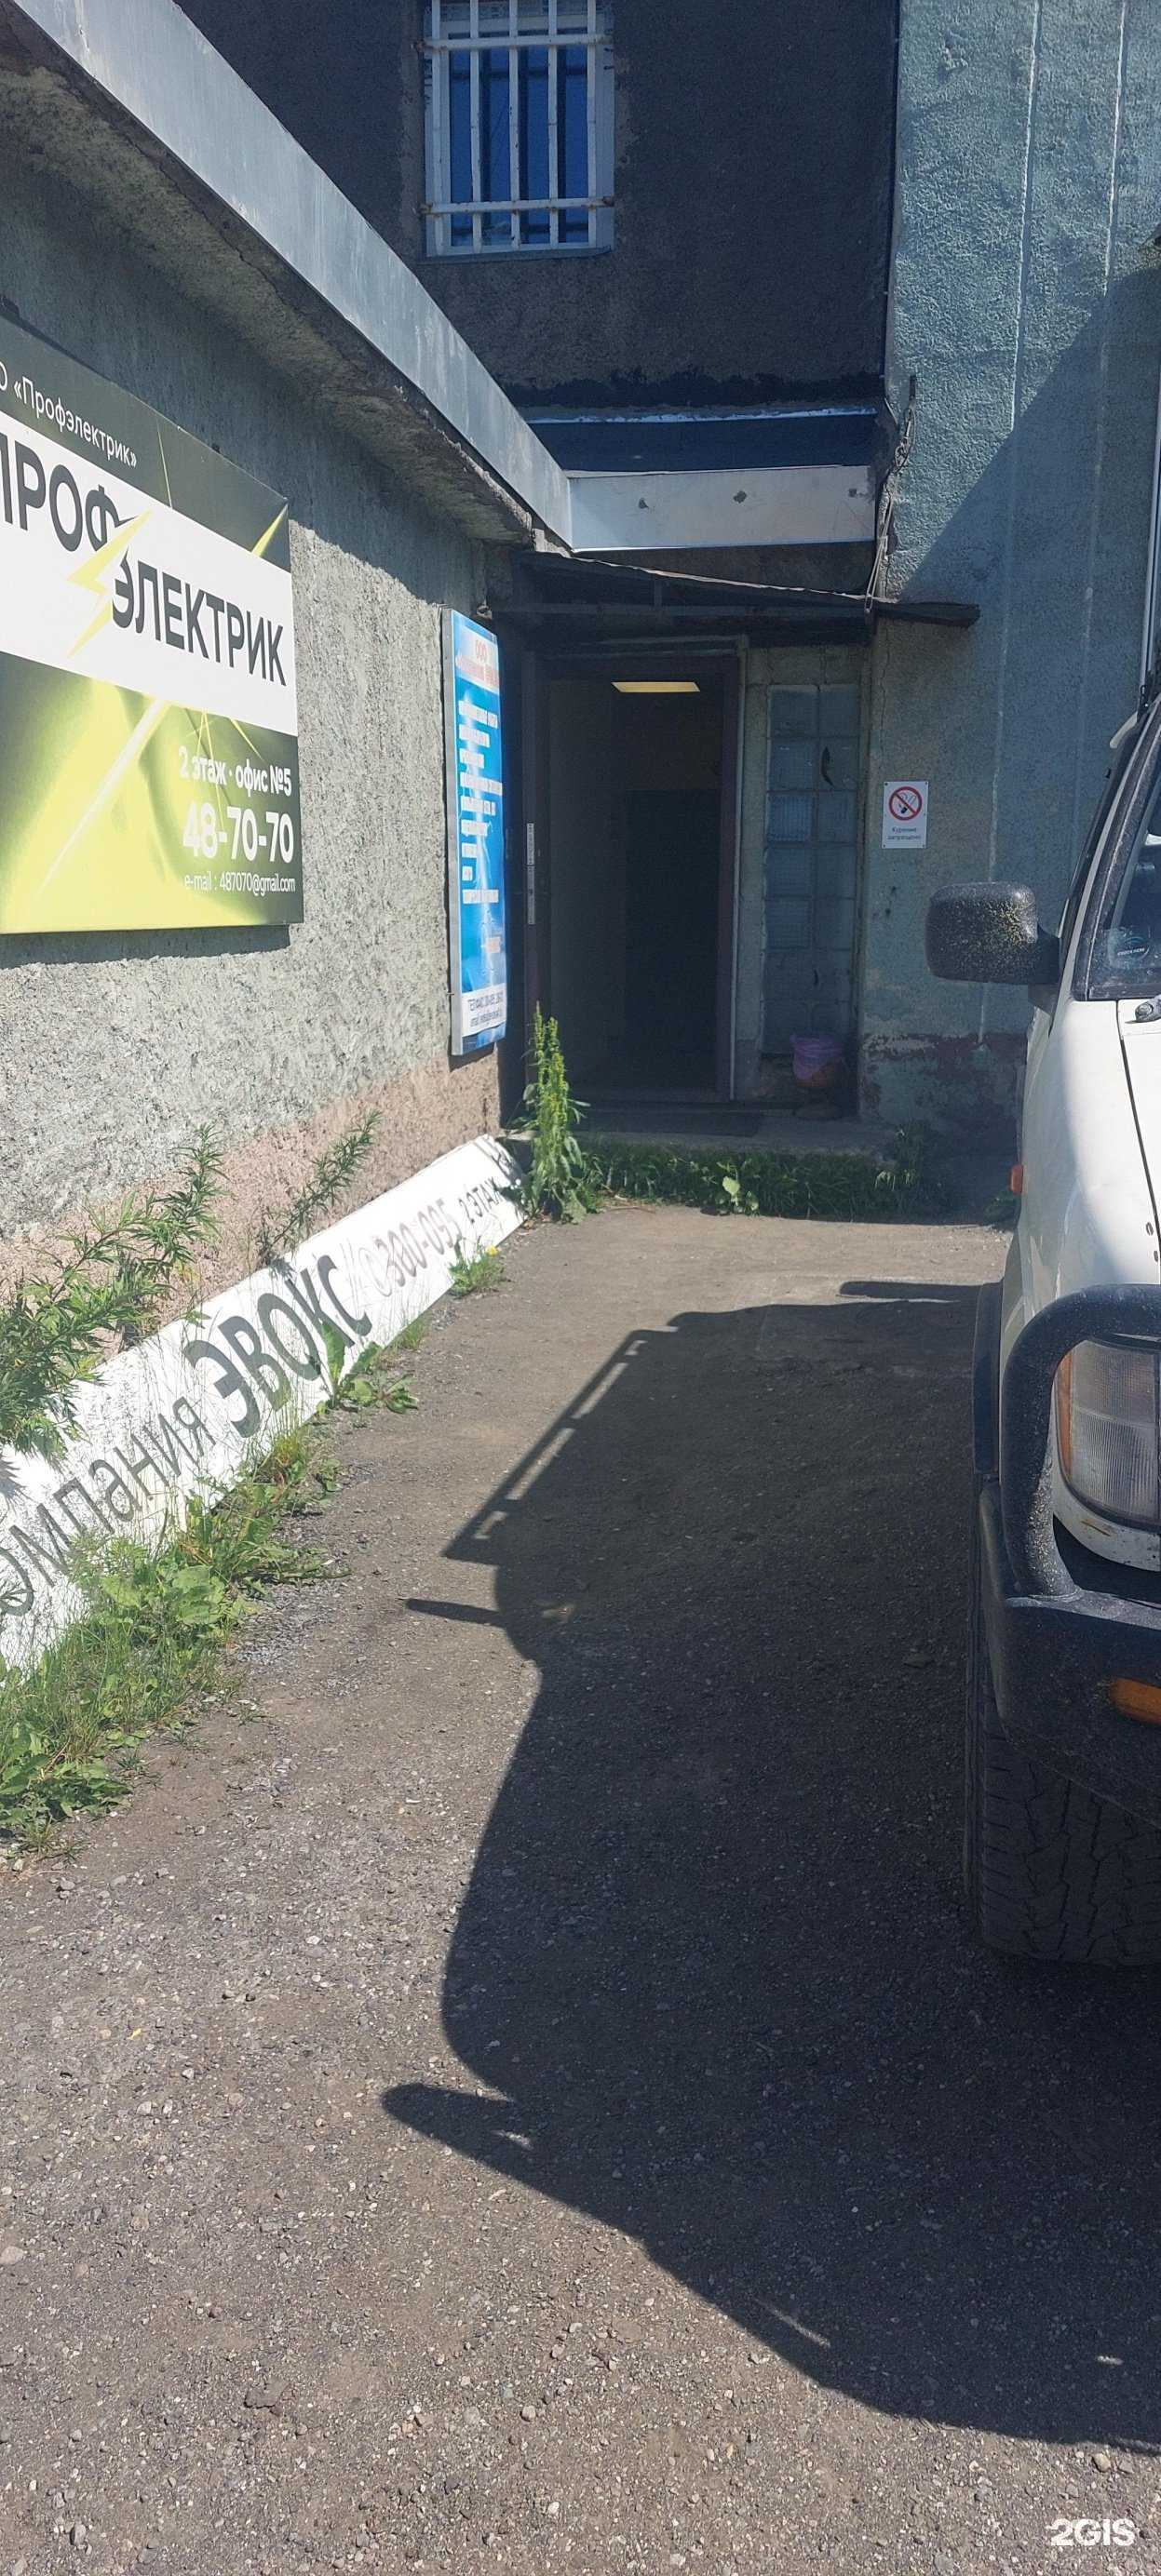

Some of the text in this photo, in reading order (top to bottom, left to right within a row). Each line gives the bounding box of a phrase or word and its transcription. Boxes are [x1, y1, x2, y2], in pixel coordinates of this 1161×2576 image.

[13, 377, 137, 468] «Профэлектрик»
[112, 546, 287, 687] ЭЛЕКТРИК
[179, 745, 189, 779] 2
[192, 757, 227, 785] этаж
[236, 759, 268, 797] офис
[269, 765, 291, 797] №5
[182, 801, 294, 864] 48-70-70
[220, 871, 296, 896] 487070@gmail.com
[185, 1254, 372, 1439] ЭВОКС
